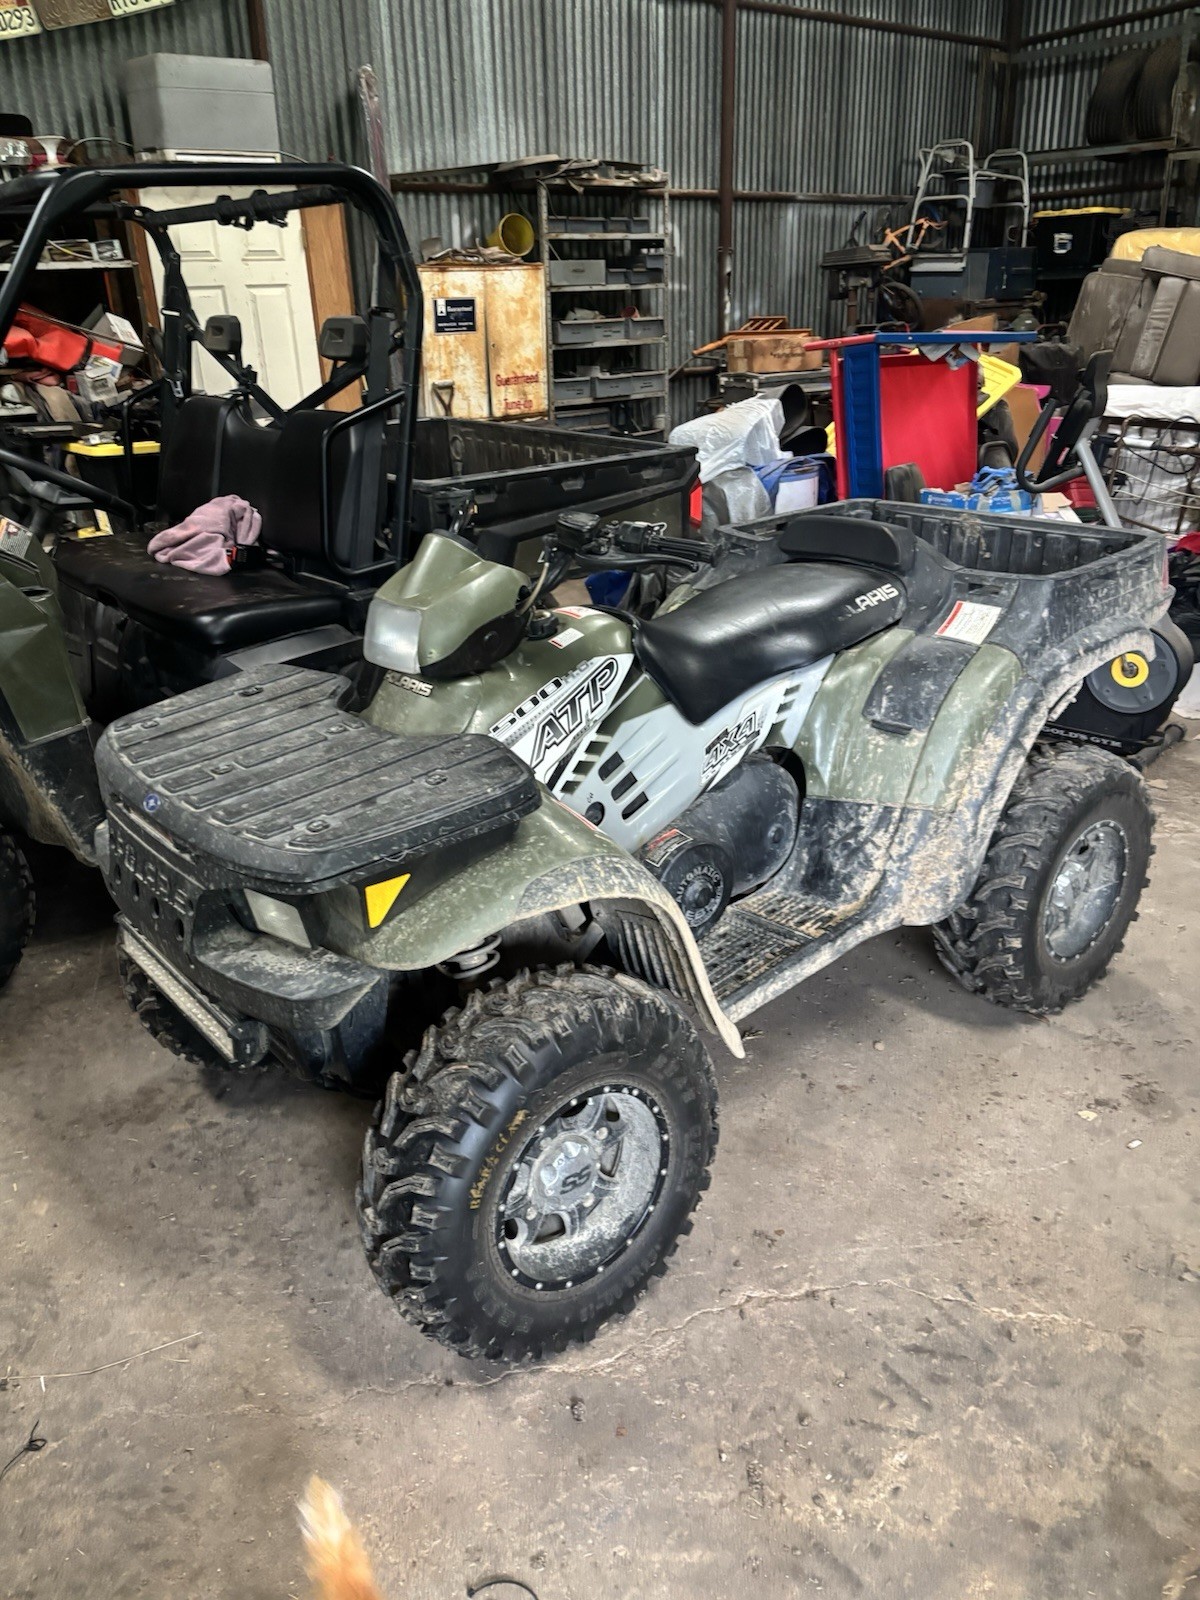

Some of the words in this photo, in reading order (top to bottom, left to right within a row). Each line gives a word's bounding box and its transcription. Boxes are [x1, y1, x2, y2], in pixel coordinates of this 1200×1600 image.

[489, 677, 563, 739] 500
[530, 657, 619, 769] ATP
[1089, 736, 1122, 748] GYM
[676, 865, 721, 903] AUTOMATIC
